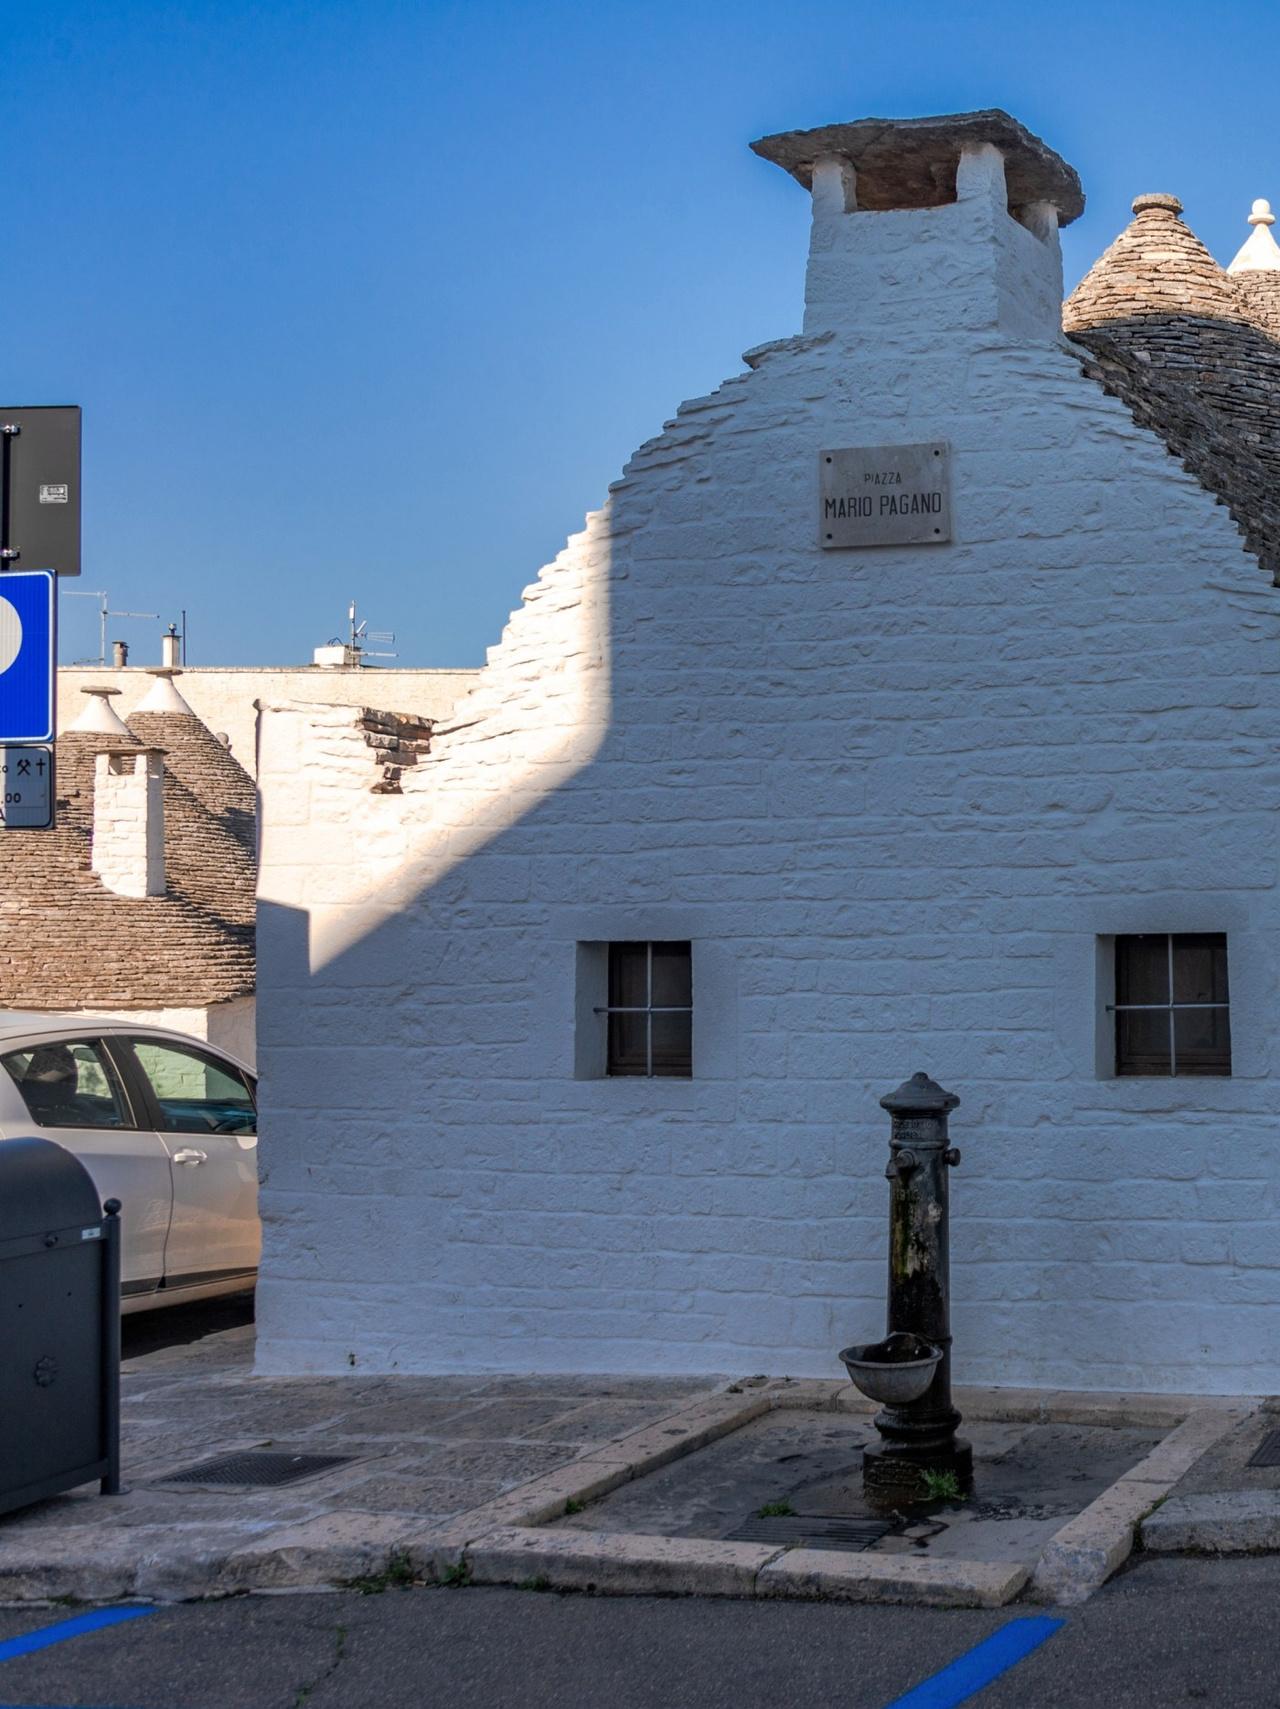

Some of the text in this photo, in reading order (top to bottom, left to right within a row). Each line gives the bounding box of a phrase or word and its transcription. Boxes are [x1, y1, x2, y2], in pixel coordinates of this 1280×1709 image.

[864, 472, 902, 485] PIAZZA
[825, 493, 941, 519] MARIO PAGANO
